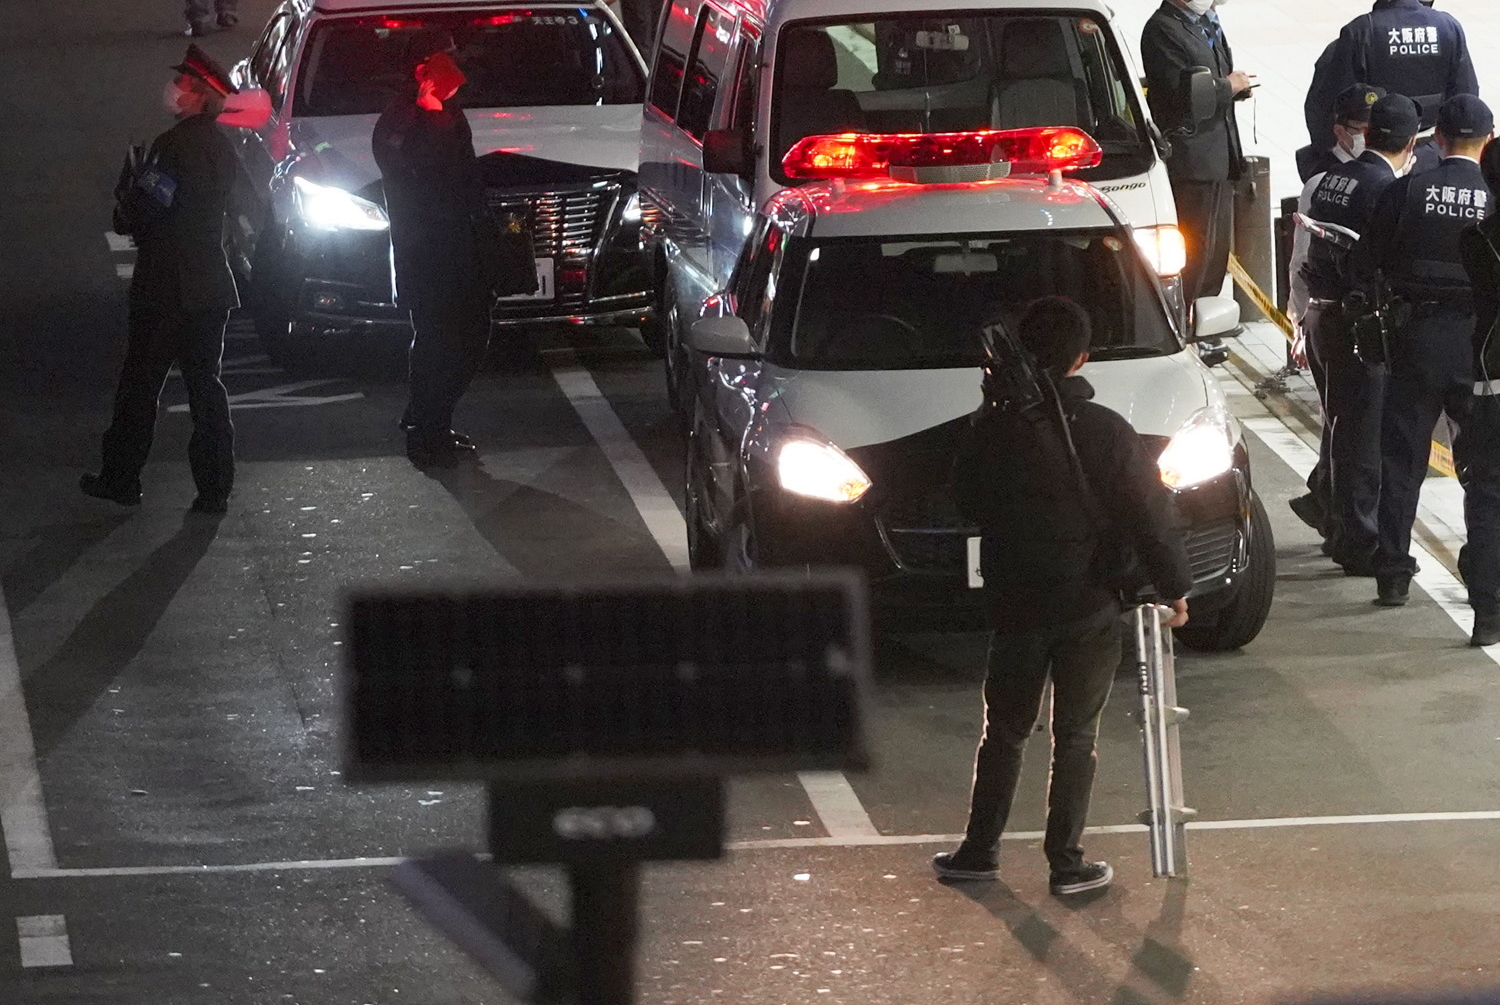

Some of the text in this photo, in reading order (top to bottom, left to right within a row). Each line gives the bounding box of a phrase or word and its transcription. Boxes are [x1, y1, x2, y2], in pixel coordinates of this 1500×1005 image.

[1388, 26, 1438, 44] 大阪府警
[1389, 44, 1439, 55] POLICE
[1100, 182, 1147, 194] Bongo
[1425, 185, 1488, 208] 大阪府警
[1316, 190, 1350, 207] POLICE
[1425, 203, 1486, 220] POLICE
